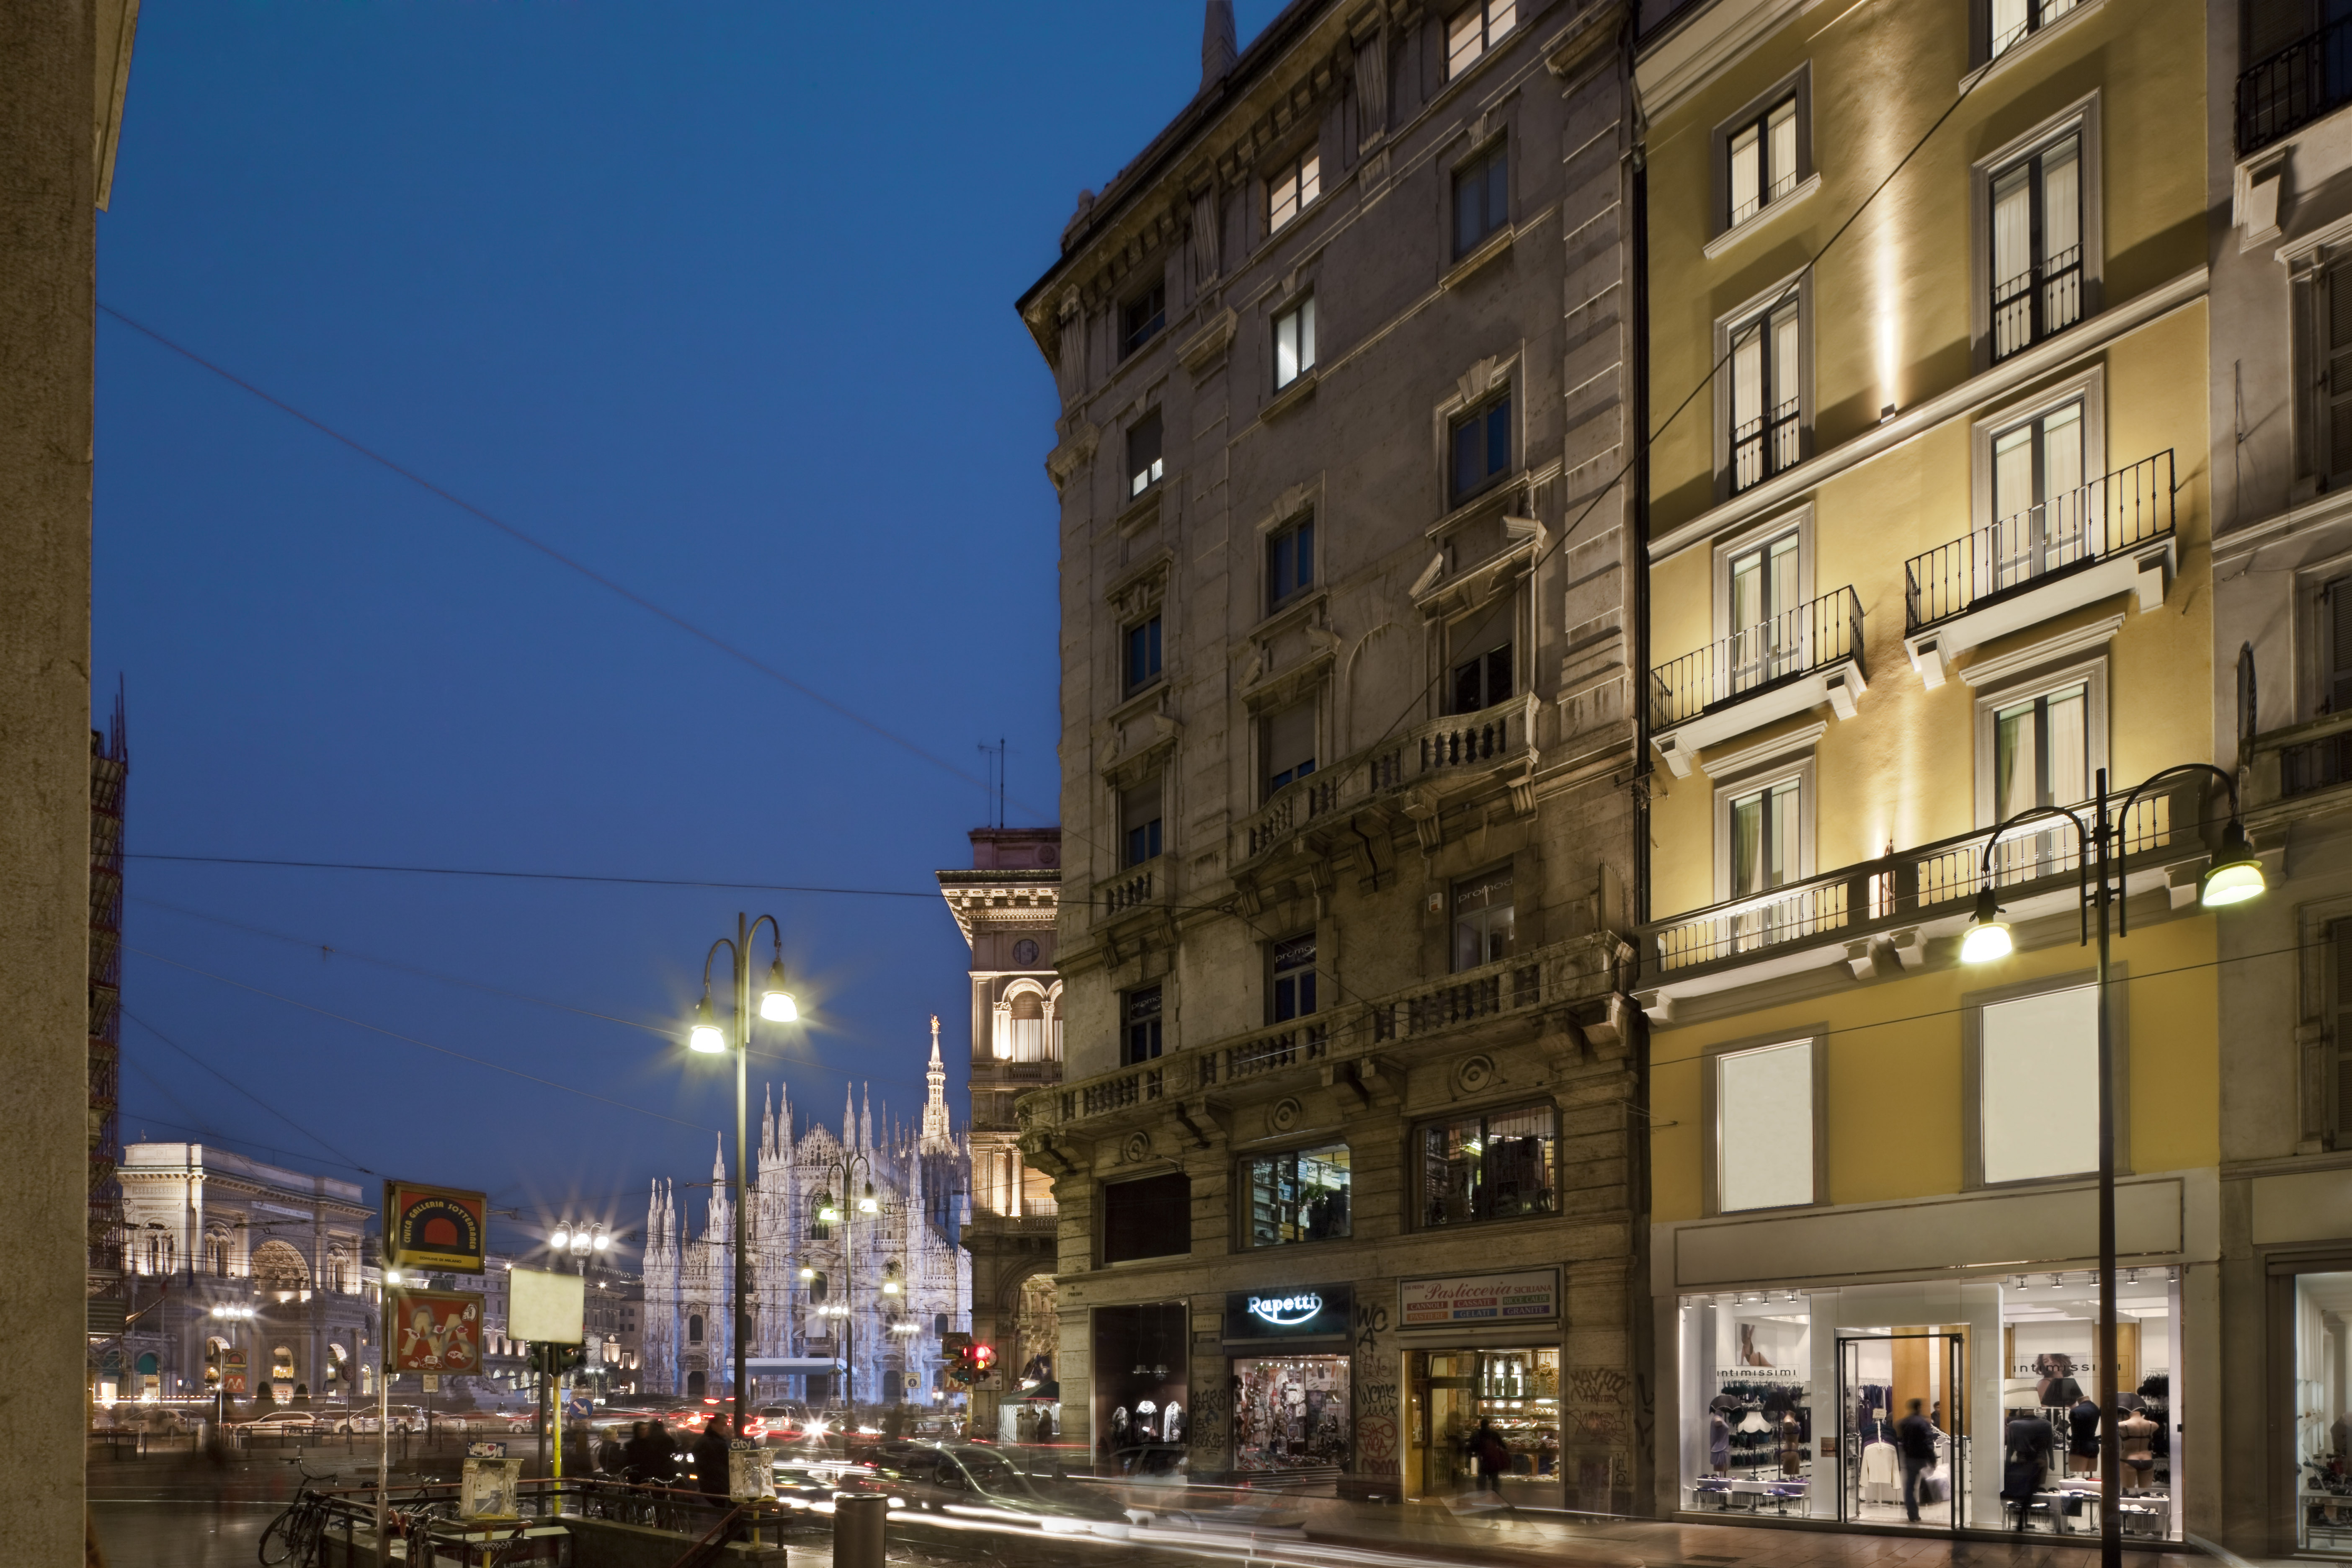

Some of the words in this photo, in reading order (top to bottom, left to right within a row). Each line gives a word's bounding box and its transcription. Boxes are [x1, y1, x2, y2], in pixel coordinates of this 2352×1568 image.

[404, 1220, 413, 1243] CIVICA
[409, 1201, 444, 1218] GALLERIA
[448, 1204, 477, 1249] SOTTERRANEA
[1425, 1281, 1512, 1300] Pasticceria
[1514, 1284, 1552, 1294] SICILIANA
[1248, 1292, 1323, 1324] Rapetti
[1457, 1299, 1492, 1307] CASSATE
[1410, 1312, 1445, 1320] PASTIERE
[1507, 1306, 1545, 1315] GRANITE
[402, 1312, 474, 1357] M
[2014, 1363, 2120, 1372] intimissii
[731, 1439, 751, 1451] city
